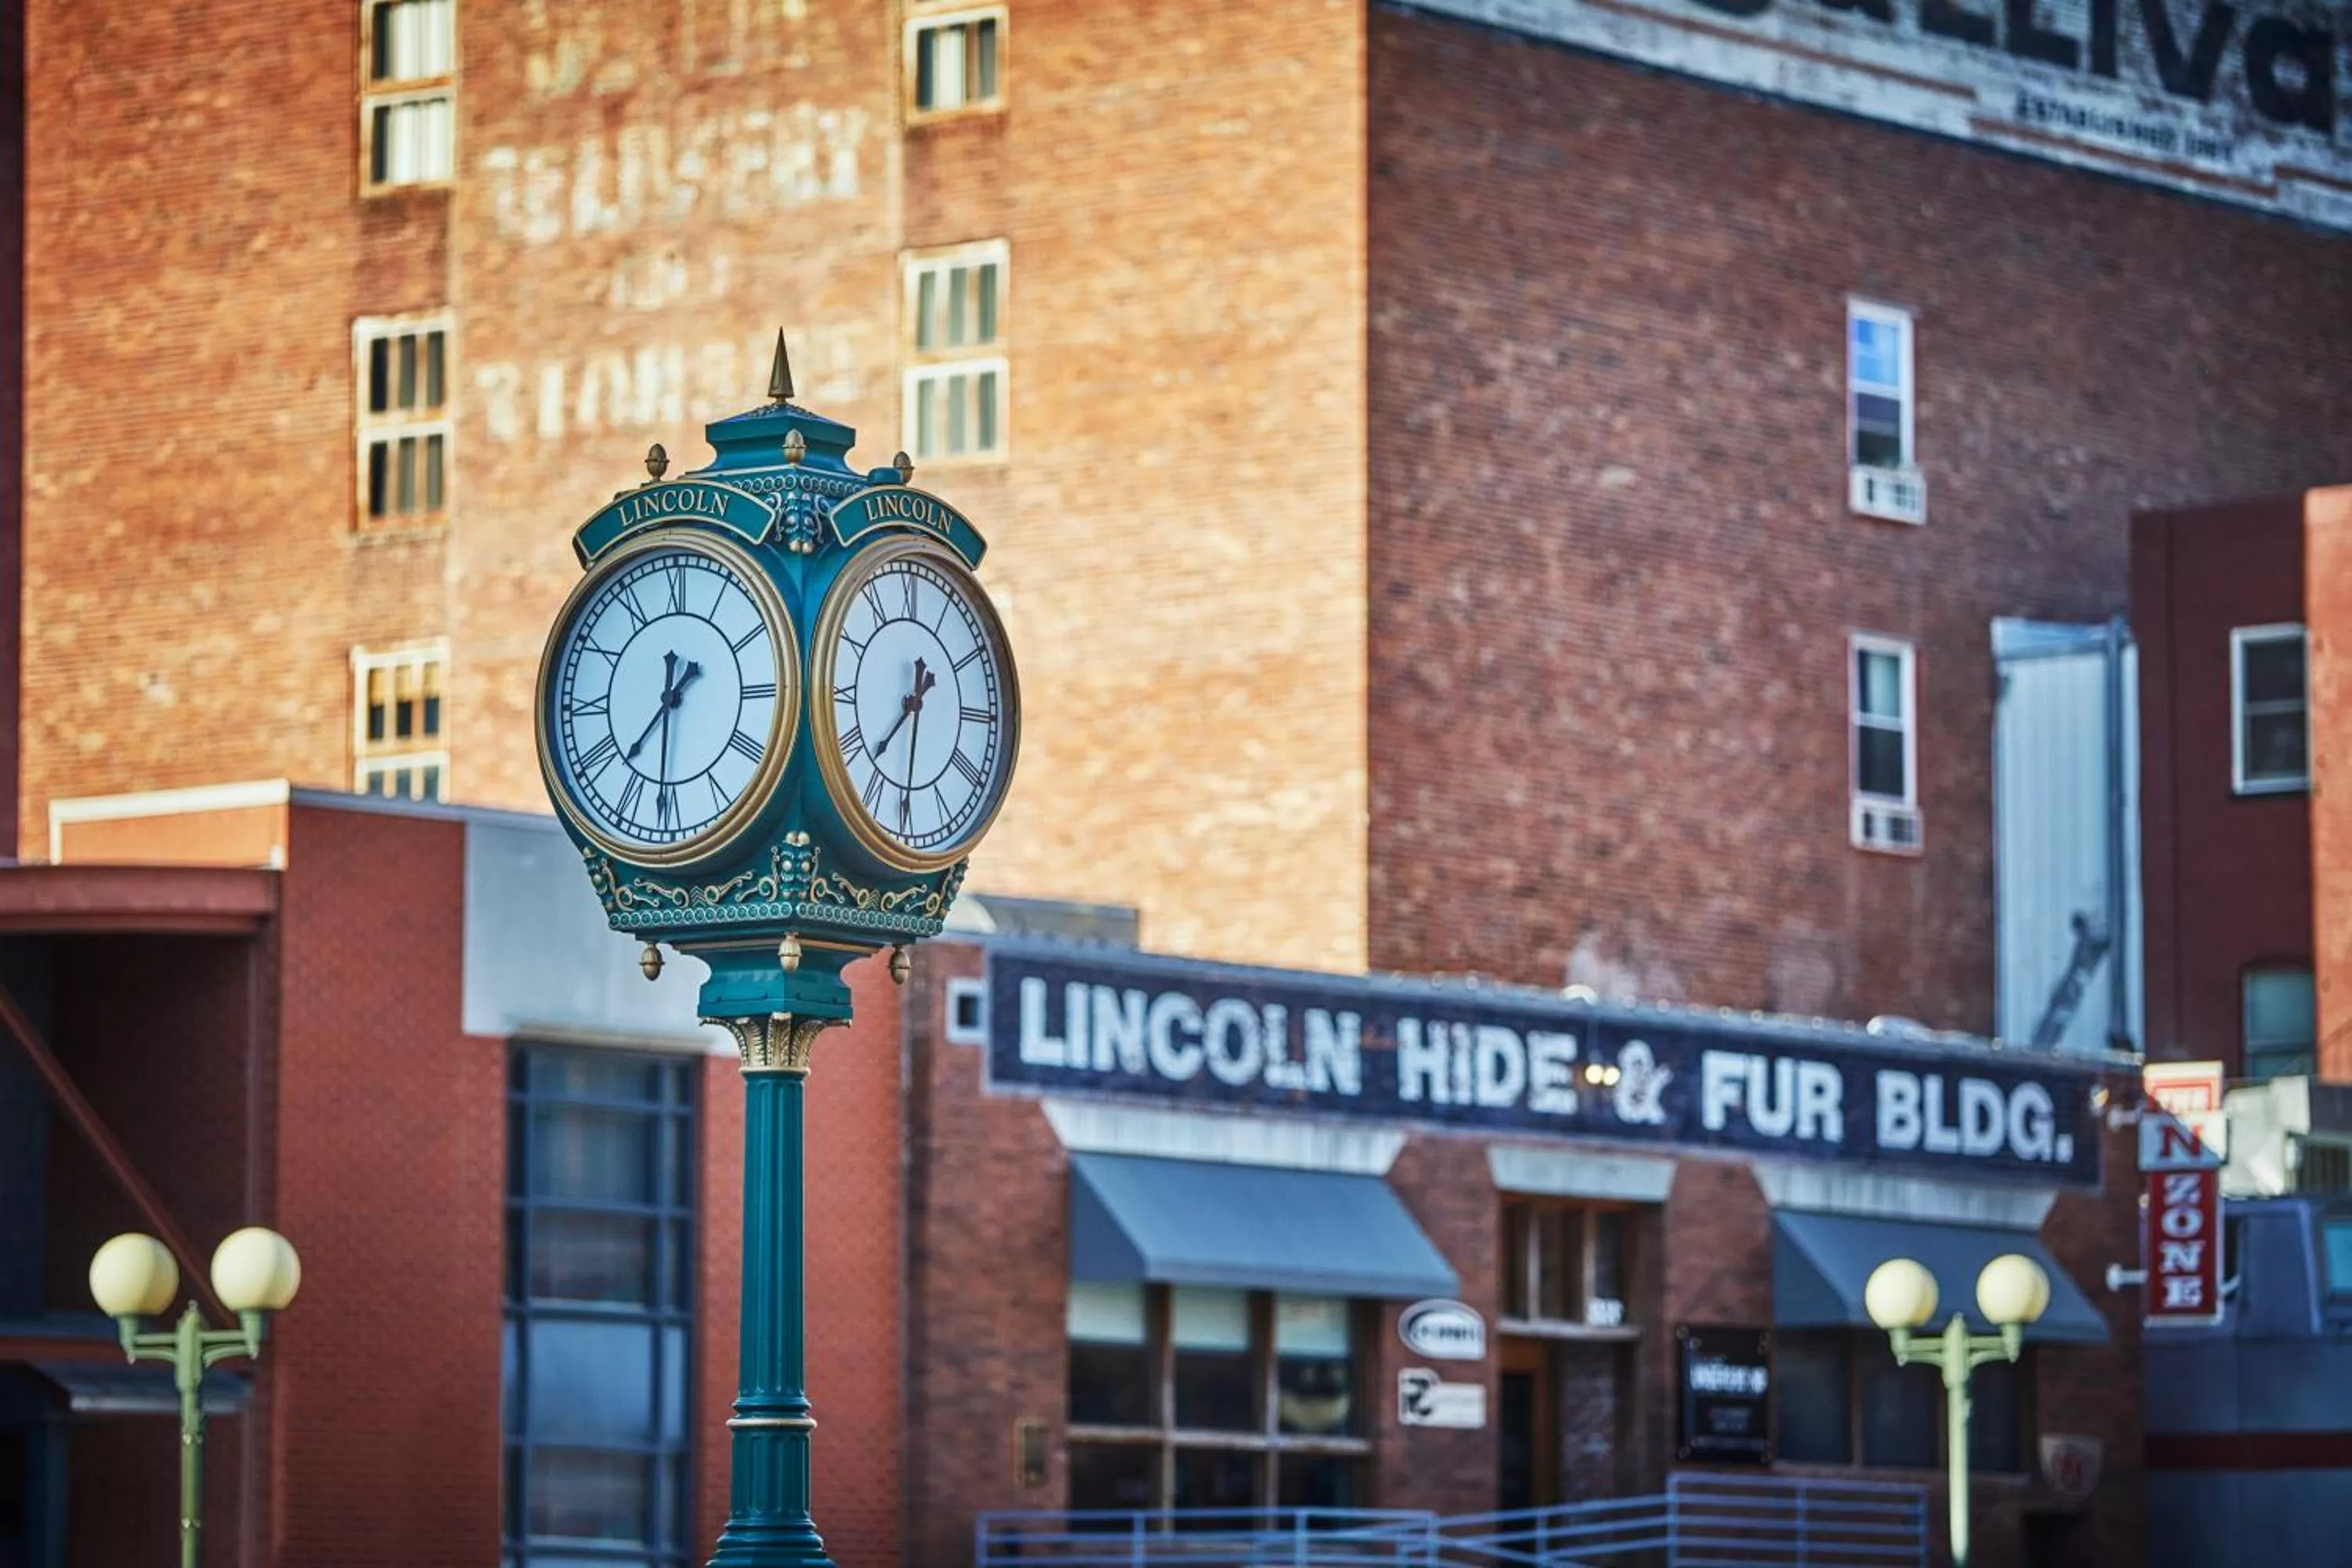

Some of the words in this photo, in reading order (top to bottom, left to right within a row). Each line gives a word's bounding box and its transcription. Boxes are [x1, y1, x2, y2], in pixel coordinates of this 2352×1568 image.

[617, 488, 731, 527] LINCOLN
[865, 495, 953, 535] LINCOLN
[1019, 977, 1362, 1095] LINCOLN
[1396, 1017, 1578, 1116] HIDE
[1616, 1038, 1673, 1125] &
[1701, 1048, 1845, 1143] FUR
[1875, 1069, 2074, 1163] BLDG.
[2160, 1173, 2205, 1308] ZONE
